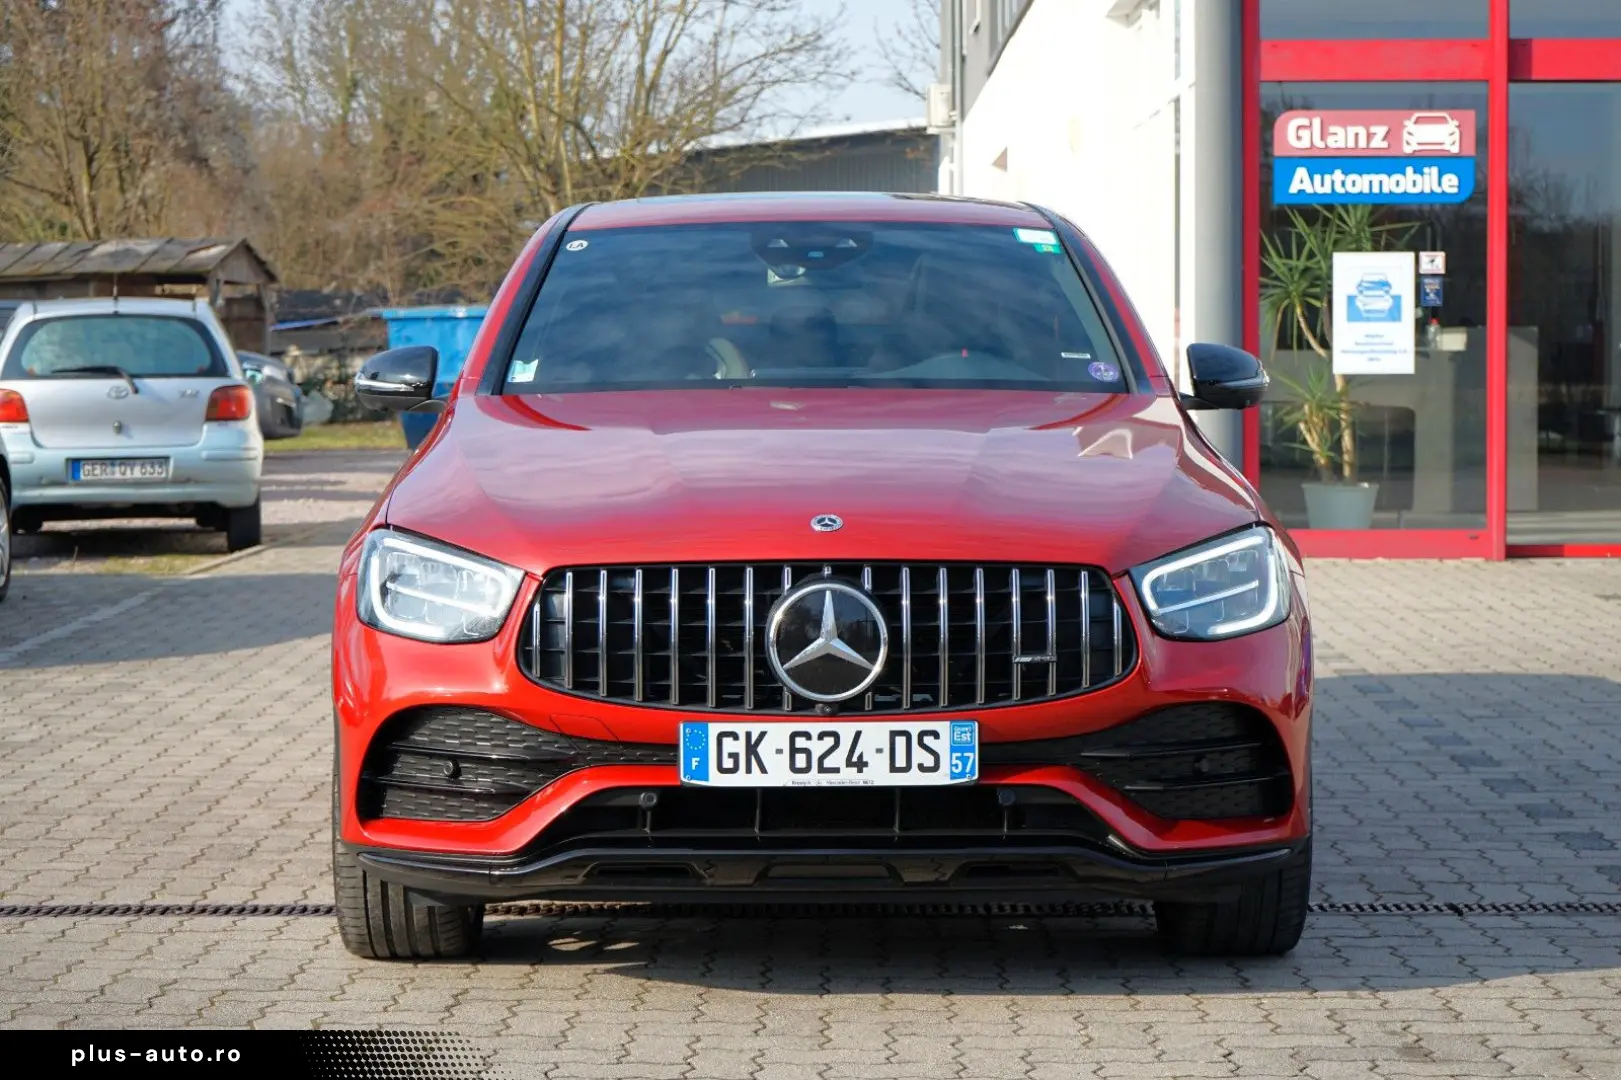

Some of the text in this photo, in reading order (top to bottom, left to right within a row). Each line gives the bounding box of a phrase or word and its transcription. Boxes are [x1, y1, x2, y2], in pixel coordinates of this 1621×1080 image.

[1287, 116, 1389, 149] Glanz
[1288, 166, 1459, 194] Automobile
[83, 462, 109, 477] GER
[954, 731, 972, 741] Est
[716, 729, 941, 774] GK-624-DS
[691, 757, 701, 770] F
[951, 752, 975, 774] 57
